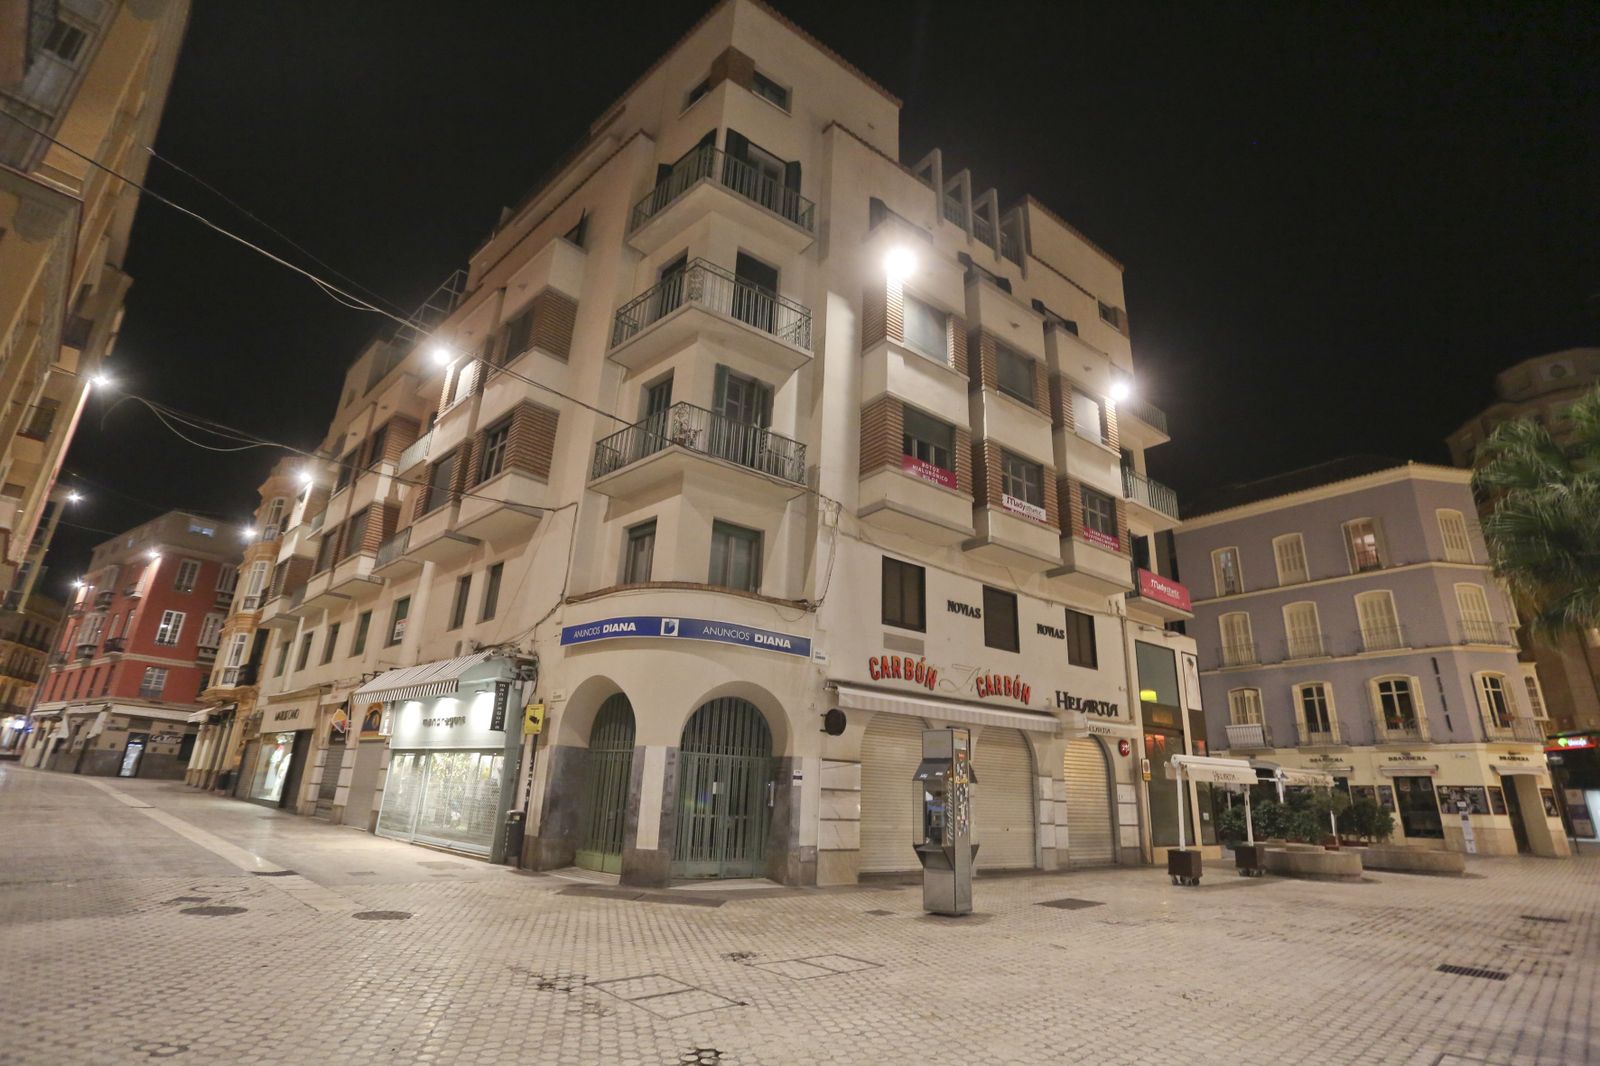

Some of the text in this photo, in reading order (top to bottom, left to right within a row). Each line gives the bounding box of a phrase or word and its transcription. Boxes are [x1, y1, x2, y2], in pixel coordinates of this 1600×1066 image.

[947, 600, 981, 619] NOVIAS
[573, 622, 636, 639] ANUNCIOS DIANA
[703, 626, 791, 649] ANUNCIOS DIANA
[1037, 623, 1065, 640] NOVIAS
[869, 655, 938, 691] CARBÓN
[976, 675, 1031, 705] CARBÓN
